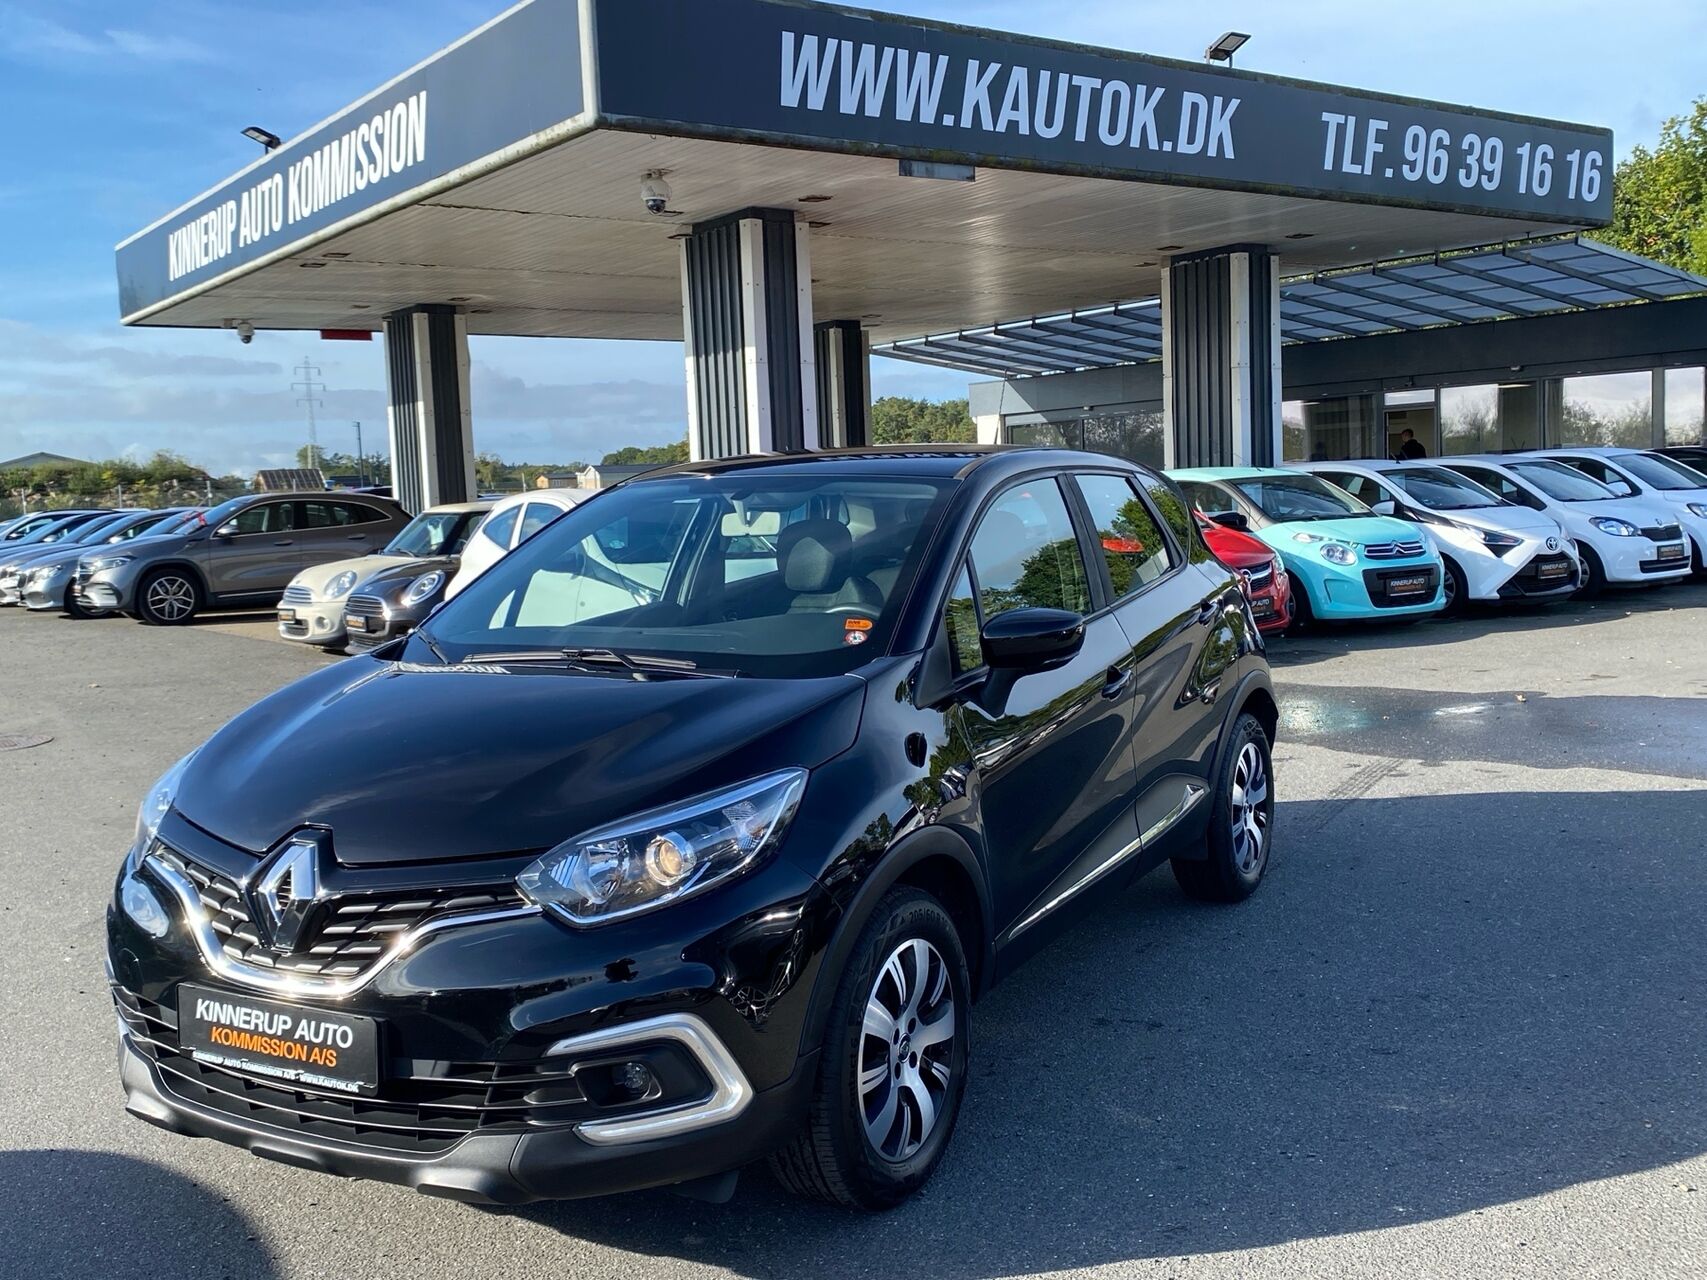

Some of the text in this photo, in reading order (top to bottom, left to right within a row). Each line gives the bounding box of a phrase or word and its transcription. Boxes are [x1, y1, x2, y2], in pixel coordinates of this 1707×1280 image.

[780, 30, 1241, 160] WWW.KAUTOK.DK
[168, 90, 427, 282] KINNERUP AUTO KOMMISSION
[1321, 112, 1603, 202] TLF. 96 39 16 16
[195, 998, 353, 1049] KINNERUP AUTO
[211, 1026, 337, 1068] KOMMISSION A/S
[223, 1057, 242, 1069] AUTO
